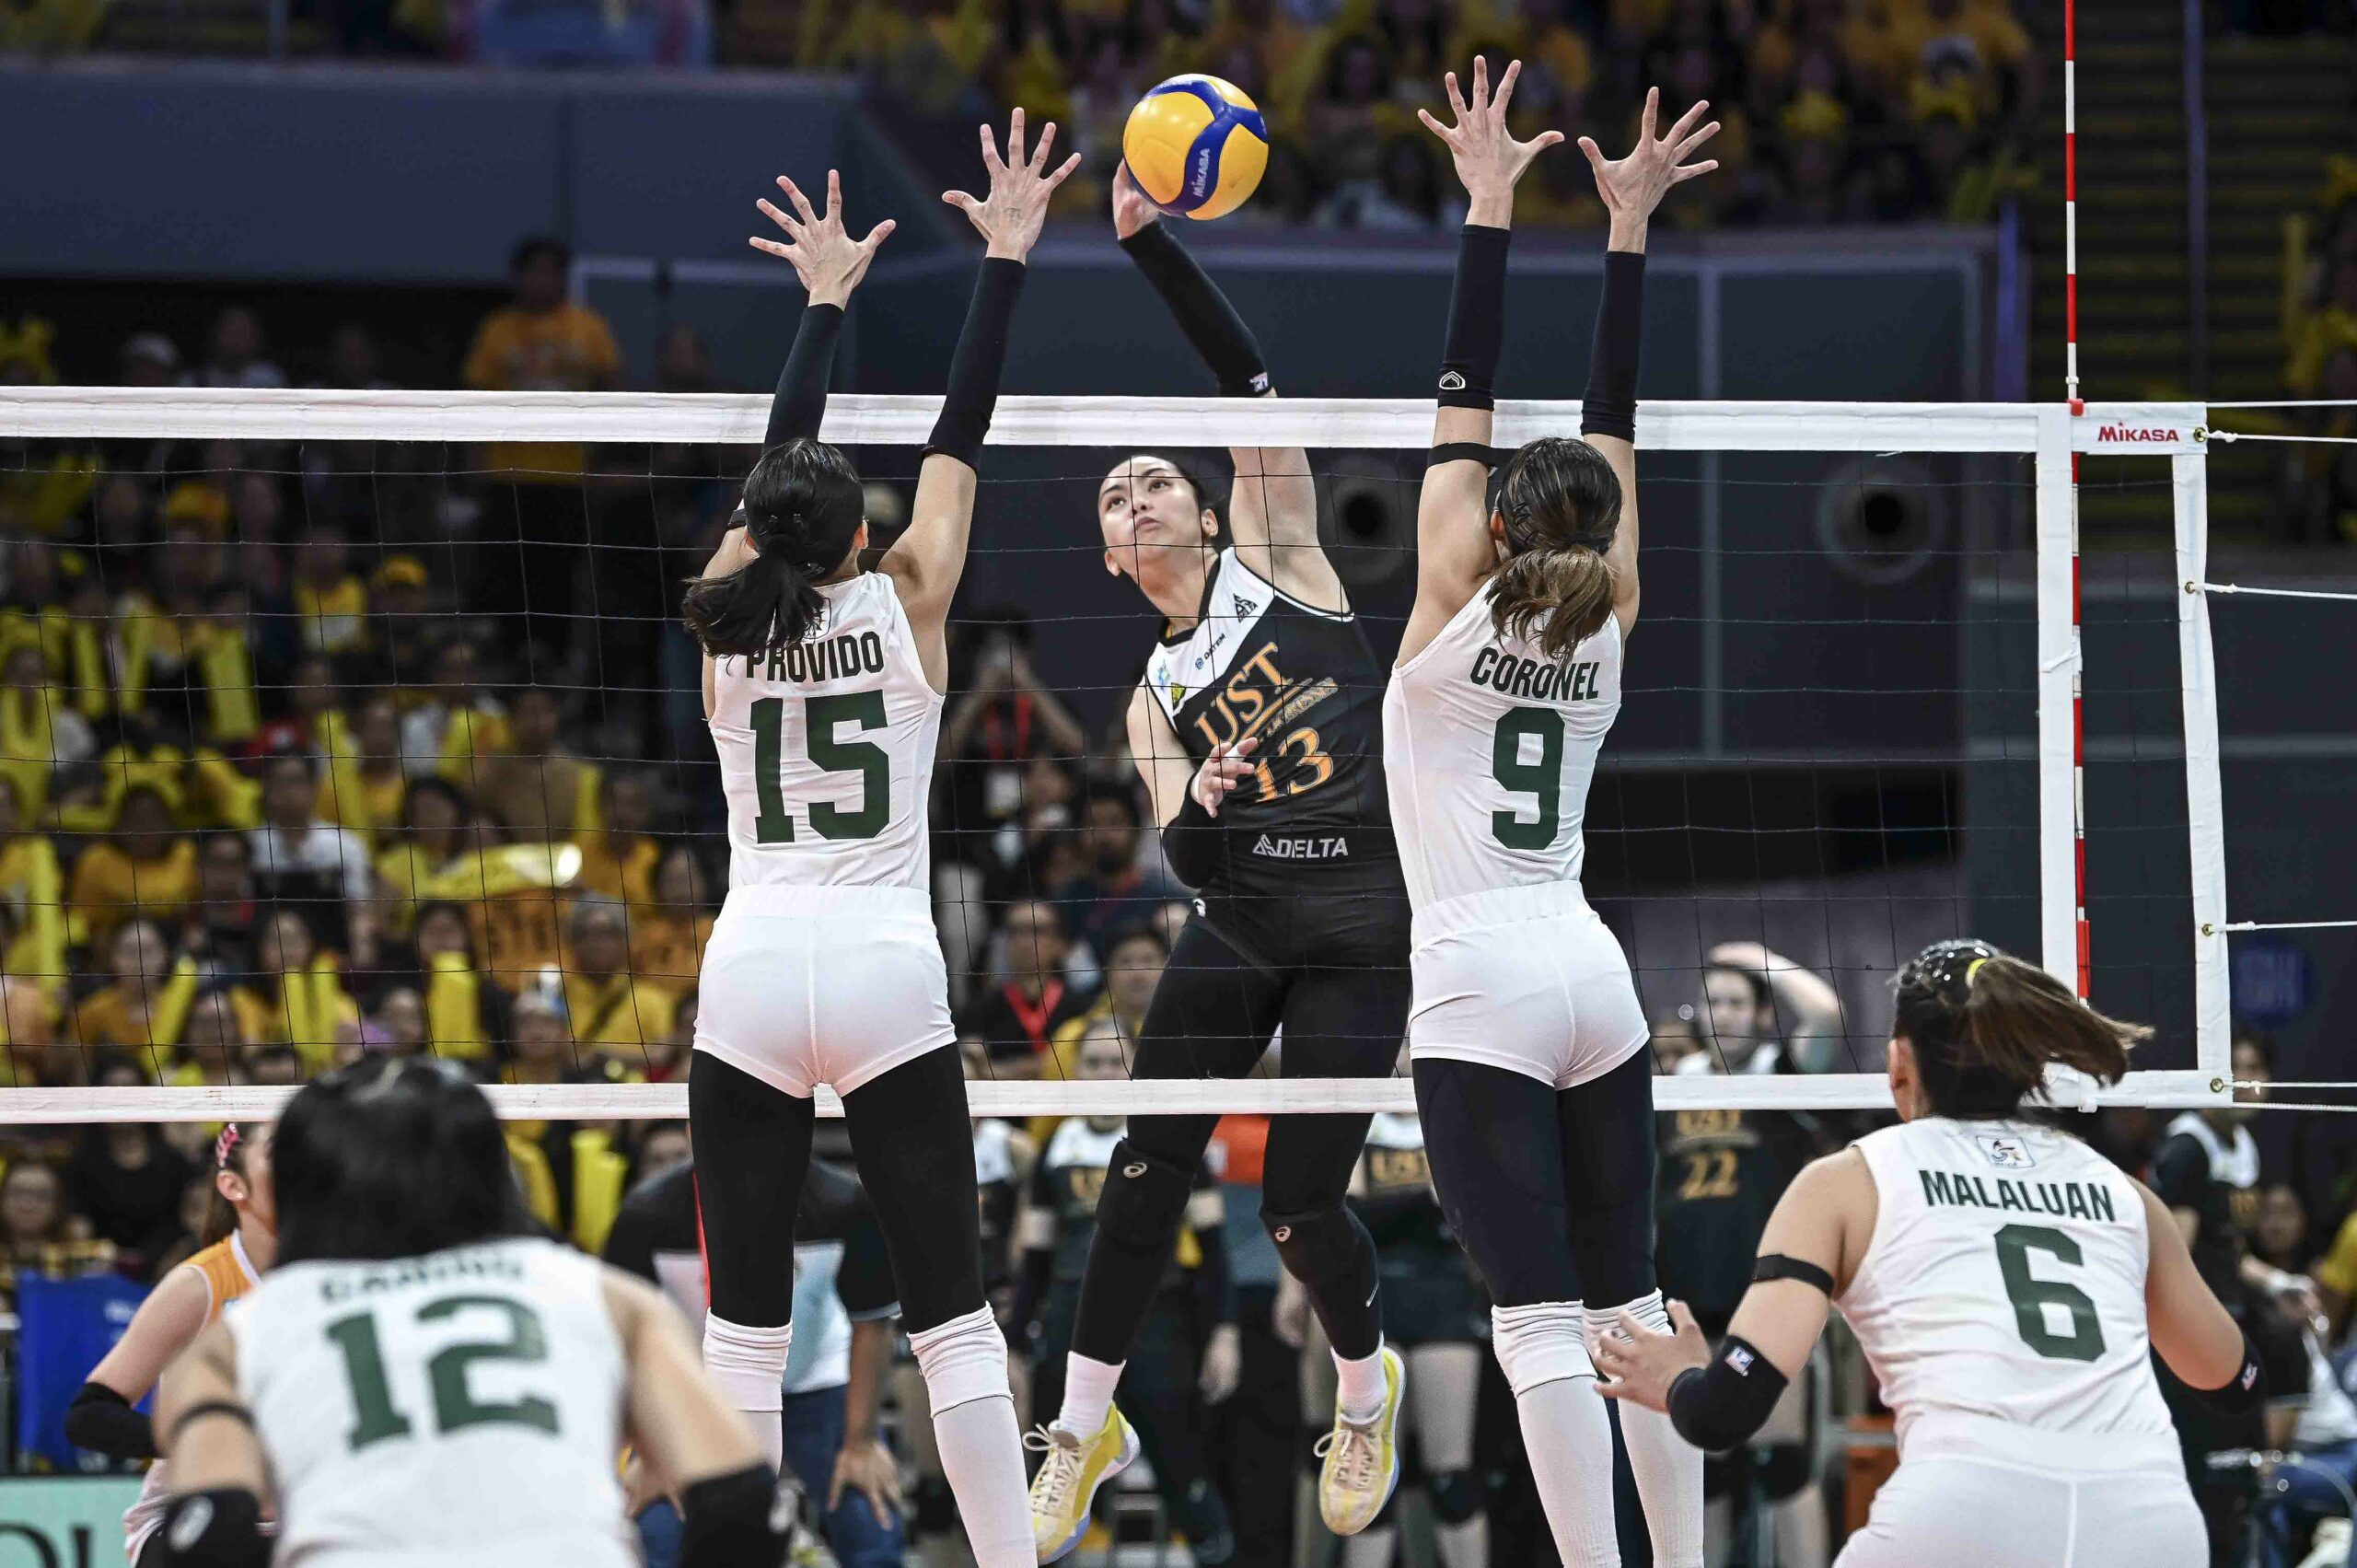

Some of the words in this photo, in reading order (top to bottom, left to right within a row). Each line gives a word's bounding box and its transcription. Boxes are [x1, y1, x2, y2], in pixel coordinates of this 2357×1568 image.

[746, 632, 885, 683] PROVIDO
[1195, 642, 1293, 748] UST
[1469, 646, 1601, 702] CORONEL
[749, 689, 890, 844] 15
[1255, 726, 1334, 803] 13
[1492, 706, 1565, 851] 9
[1276, 837, 1349, 858] DELTA
[1682, 1151, 1739, 1201] 22
[1918, 1169, 2116, 1223] MALALUAN
[1993, 1223, 2107, 1362] 6
[325, 1295, 561, 1452] 12
